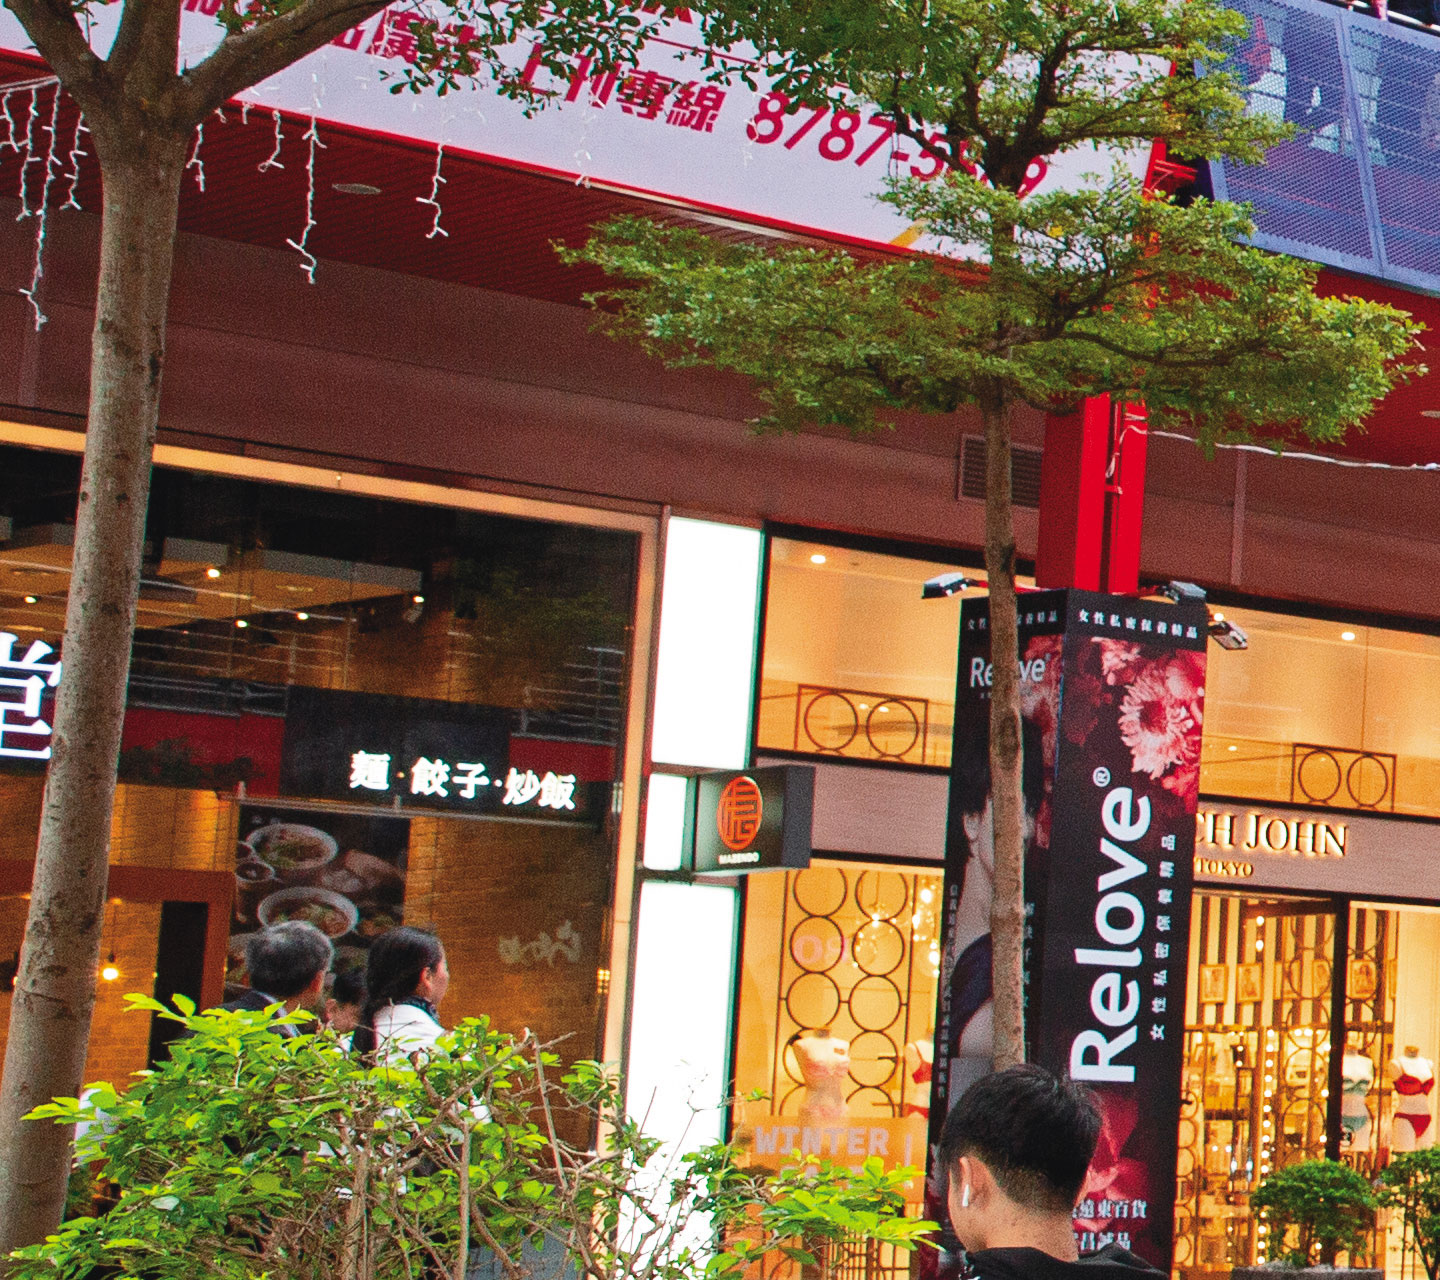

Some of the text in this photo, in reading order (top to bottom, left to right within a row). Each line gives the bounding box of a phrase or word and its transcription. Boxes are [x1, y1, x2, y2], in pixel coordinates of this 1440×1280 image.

[970, 656, 1046, 688] Reve
[1243, 811, 1347, 856] JOHN
[756, 1126, 889, 1155] WINTER
[1072, 1199, 1147, 1219] 遠東百貨
